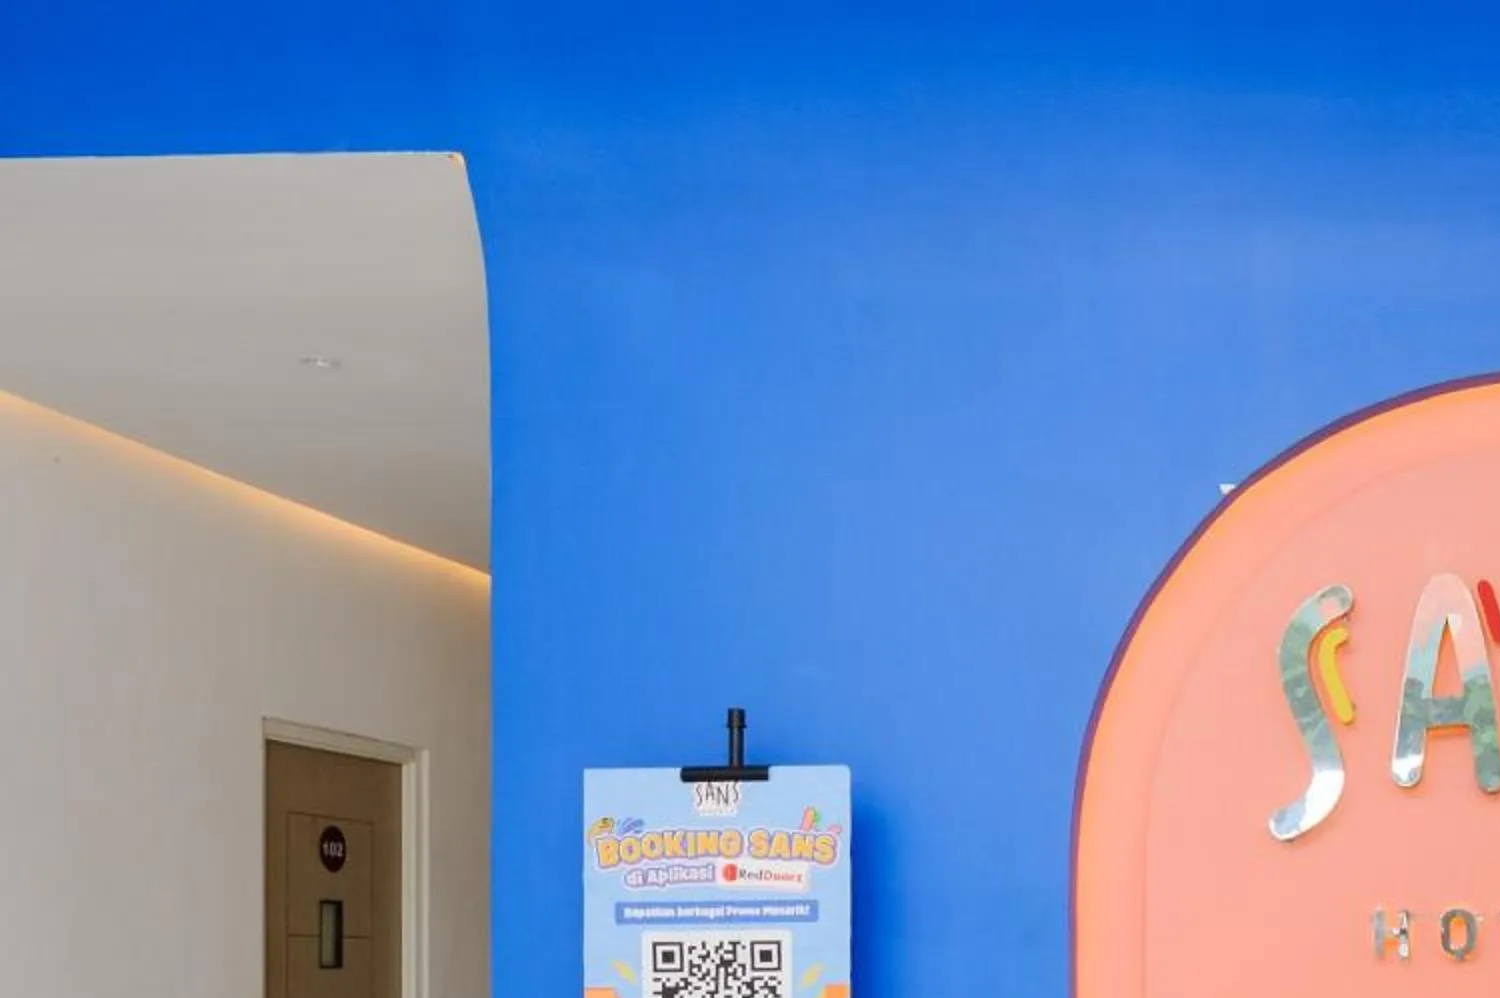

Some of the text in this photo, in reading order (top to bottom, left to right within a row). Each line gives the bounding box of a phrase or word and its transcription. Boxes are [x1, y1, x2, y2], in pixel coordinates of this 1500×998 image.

[695, 781, 739, 806] SANS
[322, 841, 344, 858] 102
[597, 829, 838, 867] BOOKING SANS
[625, 867, 643, 886] di
[647, 863, 714, 887] Aplikasi
